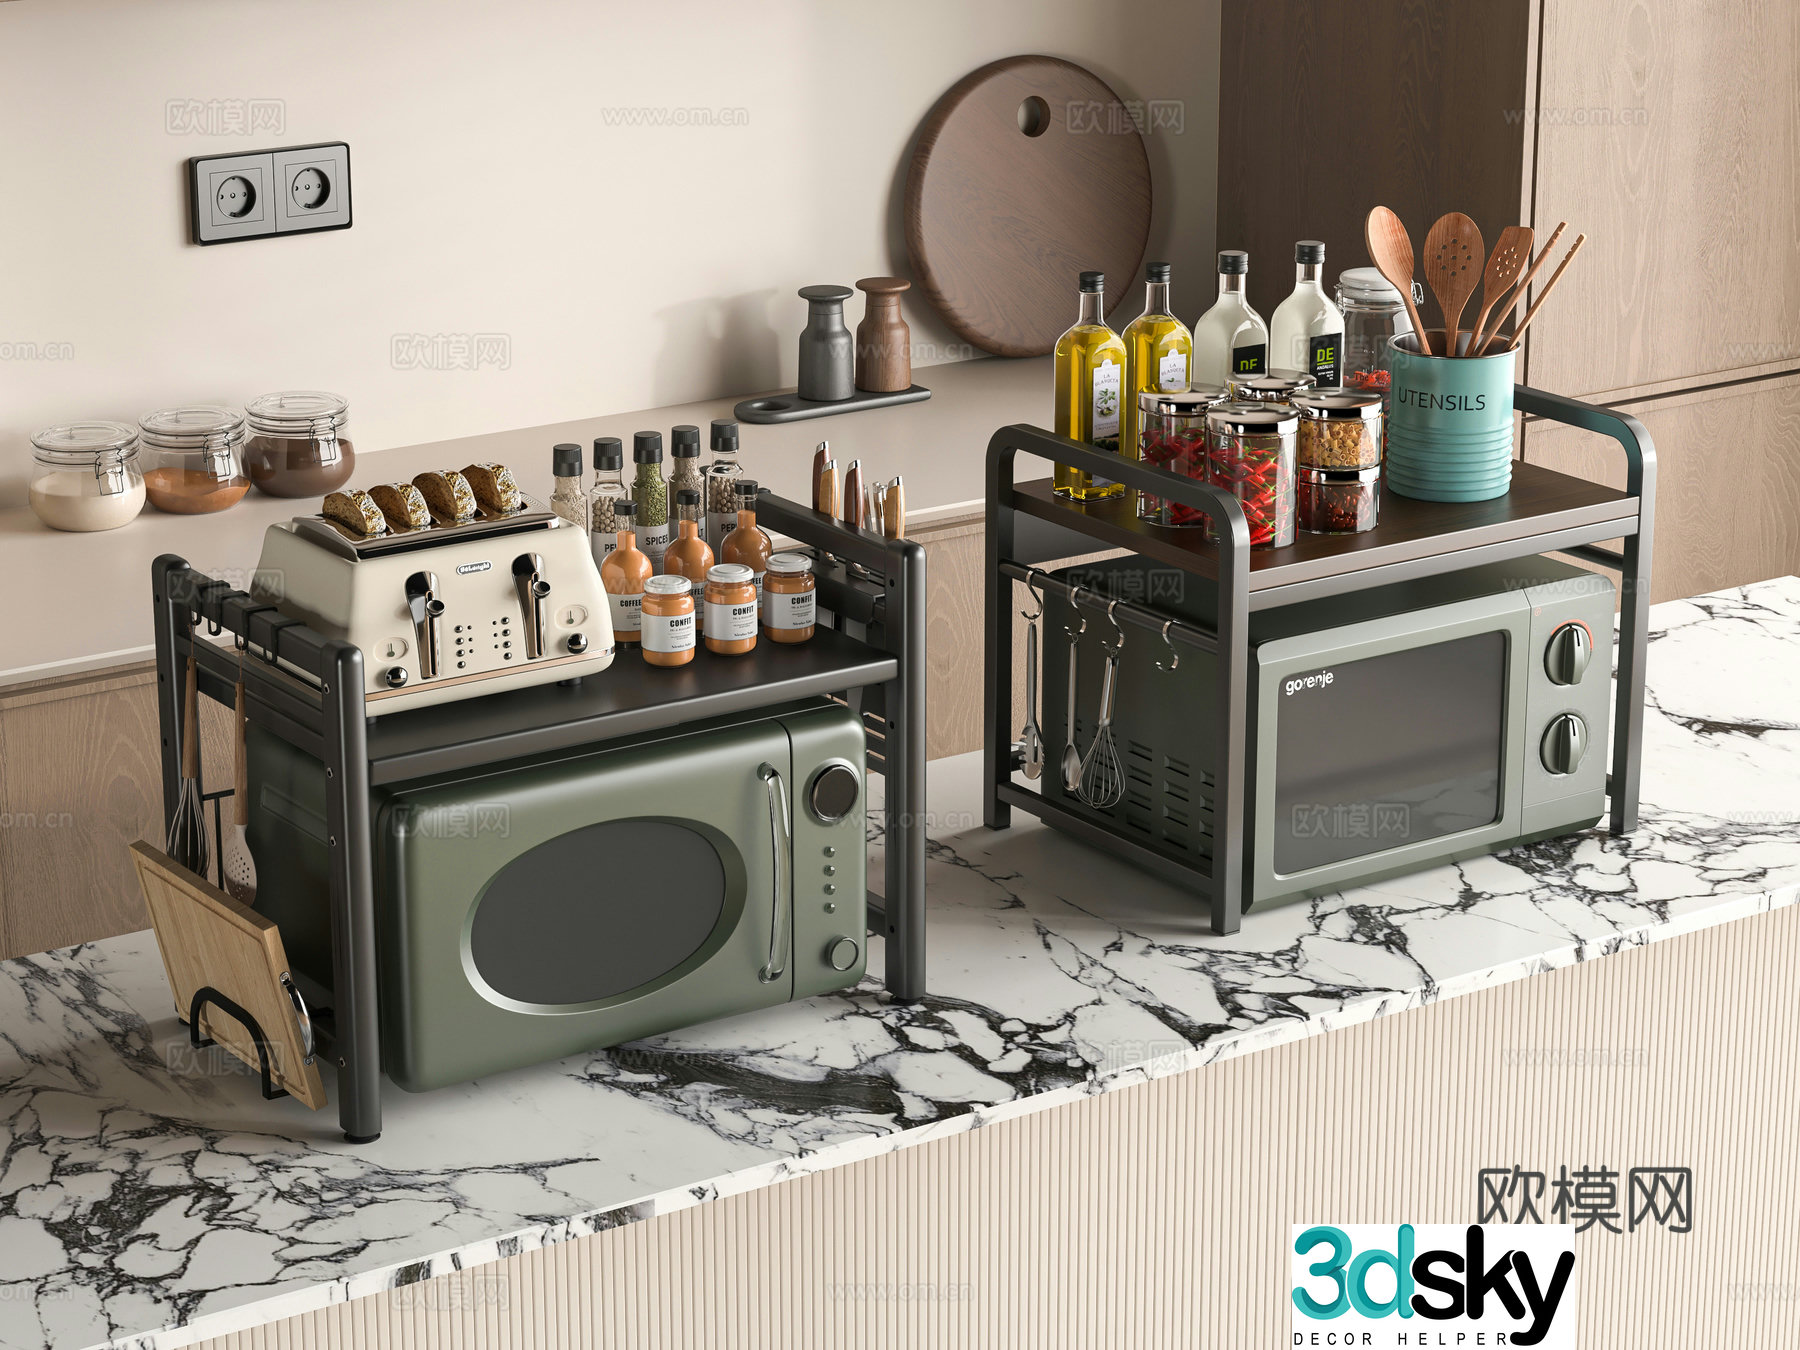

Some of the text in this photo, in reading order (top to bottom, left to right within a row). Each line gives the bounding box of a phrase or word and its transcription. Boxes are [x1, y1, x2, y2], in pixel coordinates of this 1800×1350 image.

[1316, 347, 1334, 362] DE
[1398, 387, 1486, 411] UTENSILS
[645, 534, 668, 546] SPICES
[619, 599, 642, 608] COFFEE
[791, 594, 813, 605] CONFIT
[732, 604, 754, 616] CONFIT
[669, 616, 692, 628] CONFIT
[1285, 670, 1334, 696] gorenje
